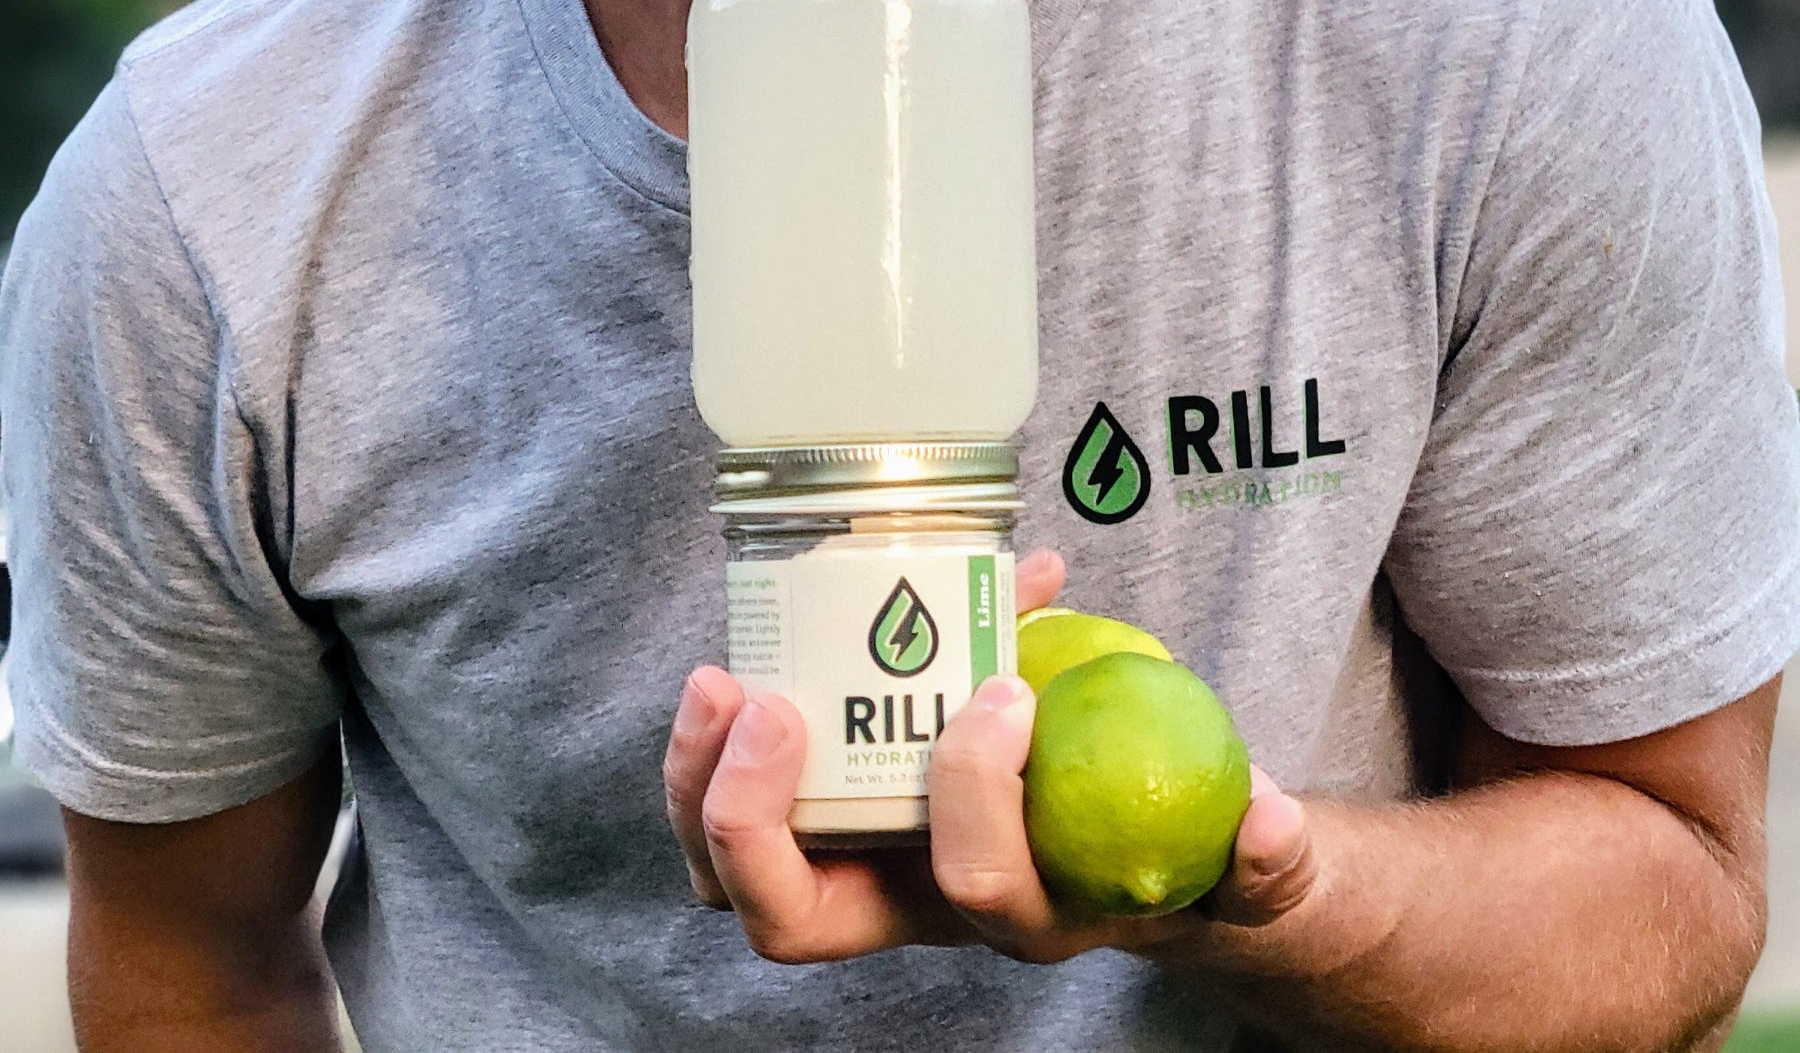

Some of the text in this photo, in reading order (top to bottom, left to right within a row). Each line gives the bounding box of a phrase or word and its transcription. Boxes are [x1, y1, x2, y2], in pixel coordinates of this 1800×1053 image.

[1167, 378, 1346, 476] RILL
[1176, 470, 1343, 509] HYDRATION
[977, 573, 990, 627] Lime
[847, 750, 932, 766] HYDRATI
